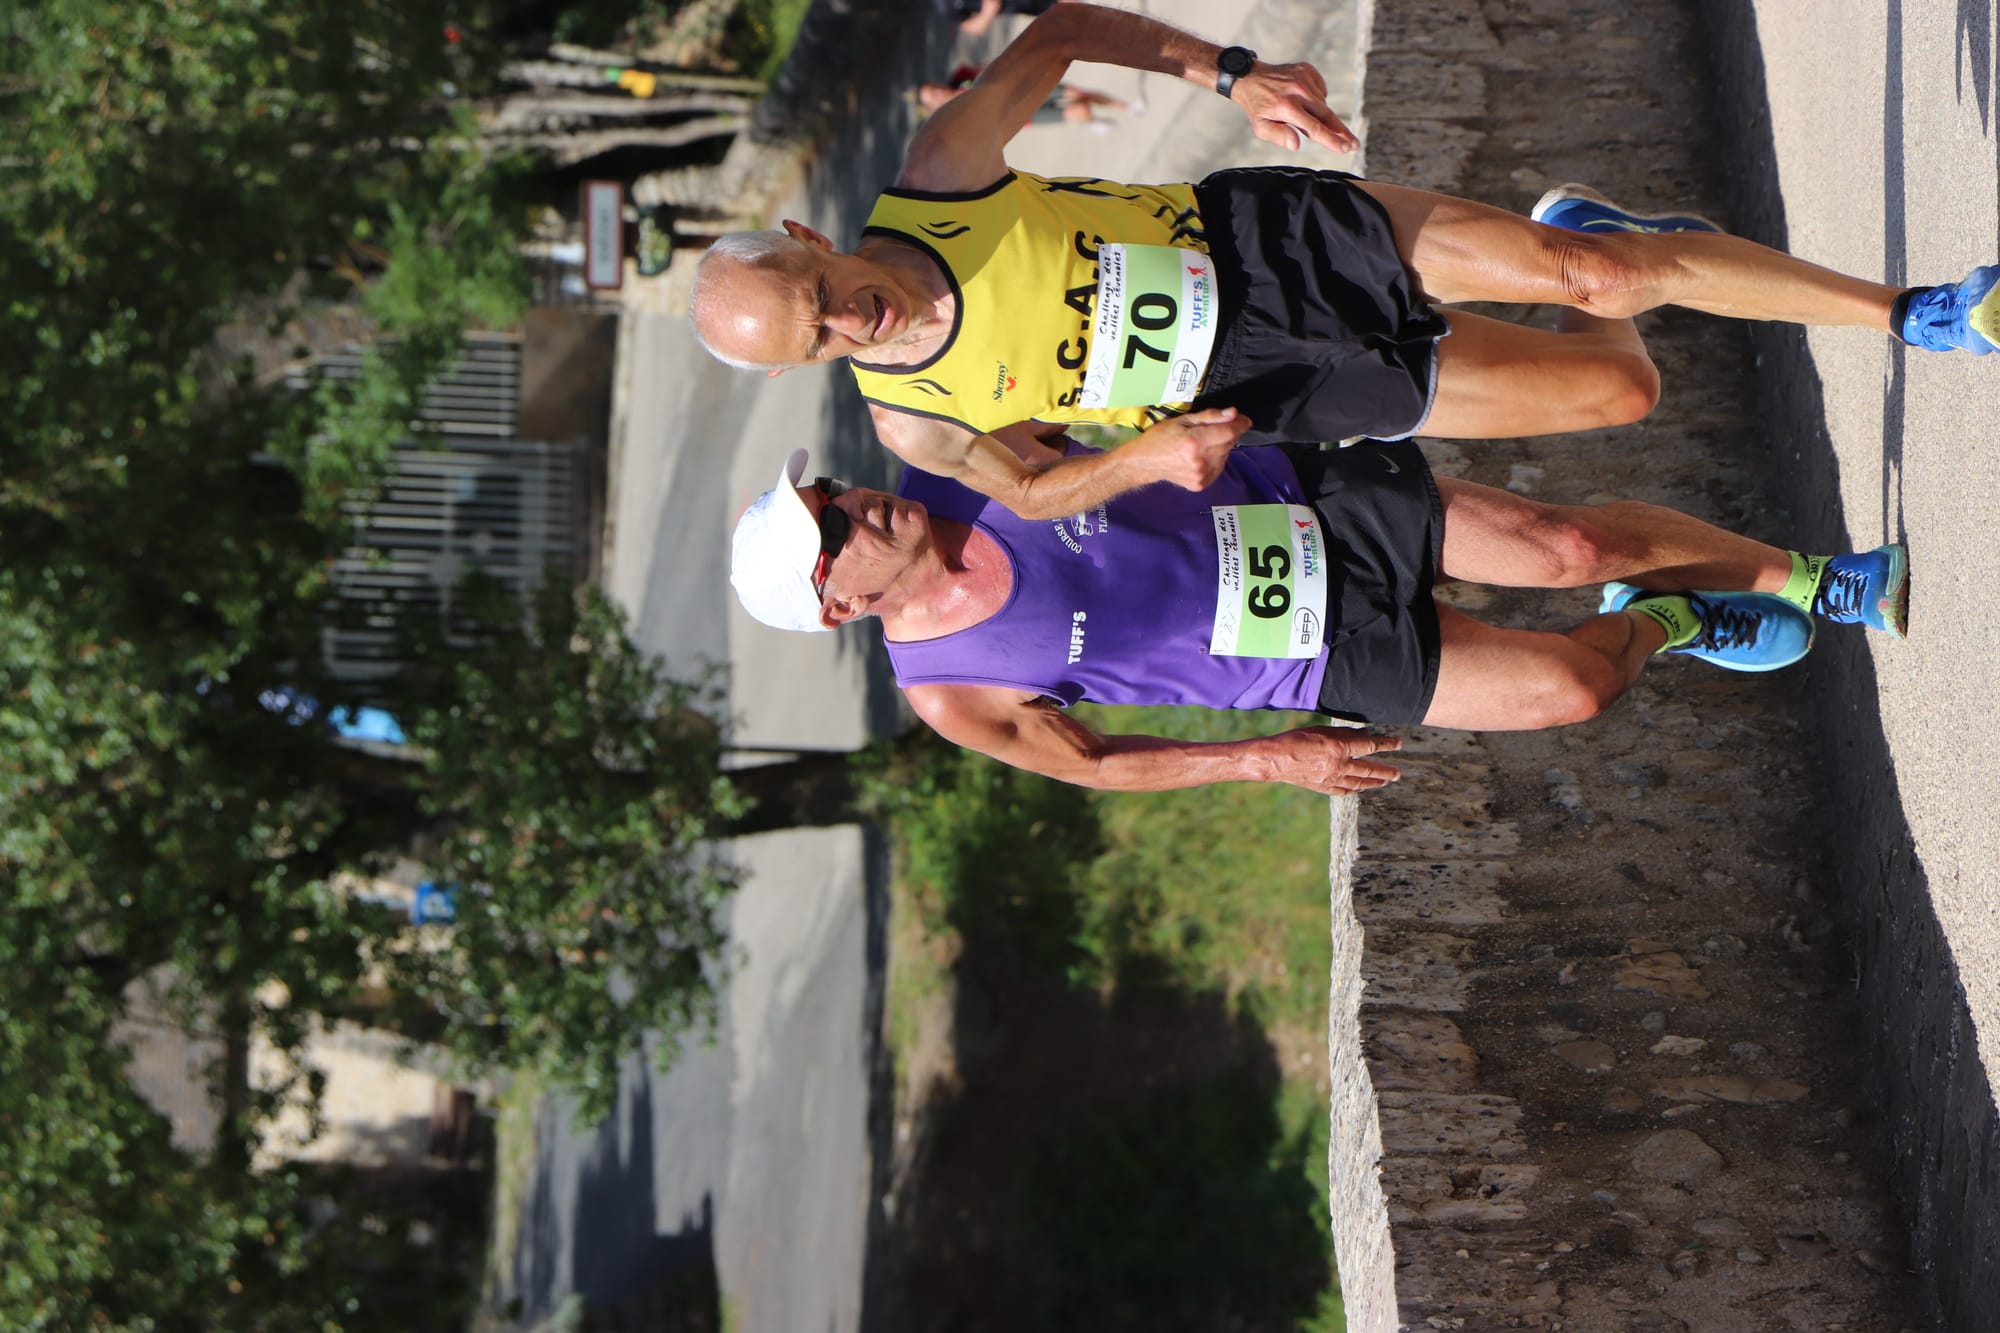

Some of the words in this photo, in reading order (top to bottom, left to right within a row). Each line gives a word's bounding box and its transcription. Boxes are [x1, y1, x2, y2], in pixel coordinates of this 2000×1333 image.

[1103, 256, 1111, 274] des
[1112, 251, 1121, 298] cévenoles
[1099, 281, 1113, 334] Challenge
[1110, 305, 1120, 341] vallées
[1191, 281, 1202, 331] TUFF'S
[1199, 276, 1209, 328] Aventure
[1123, 292, 1178, 369] 70
[992, 361, 1008, 402] Shemsy
[1176, 364, 1191, 392] BFP
[1054, 524, 1083, 554] COURSE
[1218, 517, 1227, 532] des
[1227, 512, 1238, 551] cévenoles
[1223, 537, 1233, 586] Challenge
[1301, 533, 1313, 579] TUFF'S
[1309, 528, 1319, 574] Aventure
[1230, 558, 1239, 591] vallées
[1248, 545, 1291, 619] 65
[1068, 611, 1087, 665] TUFF'S
[1300, 612, 1311, 644] BFP
